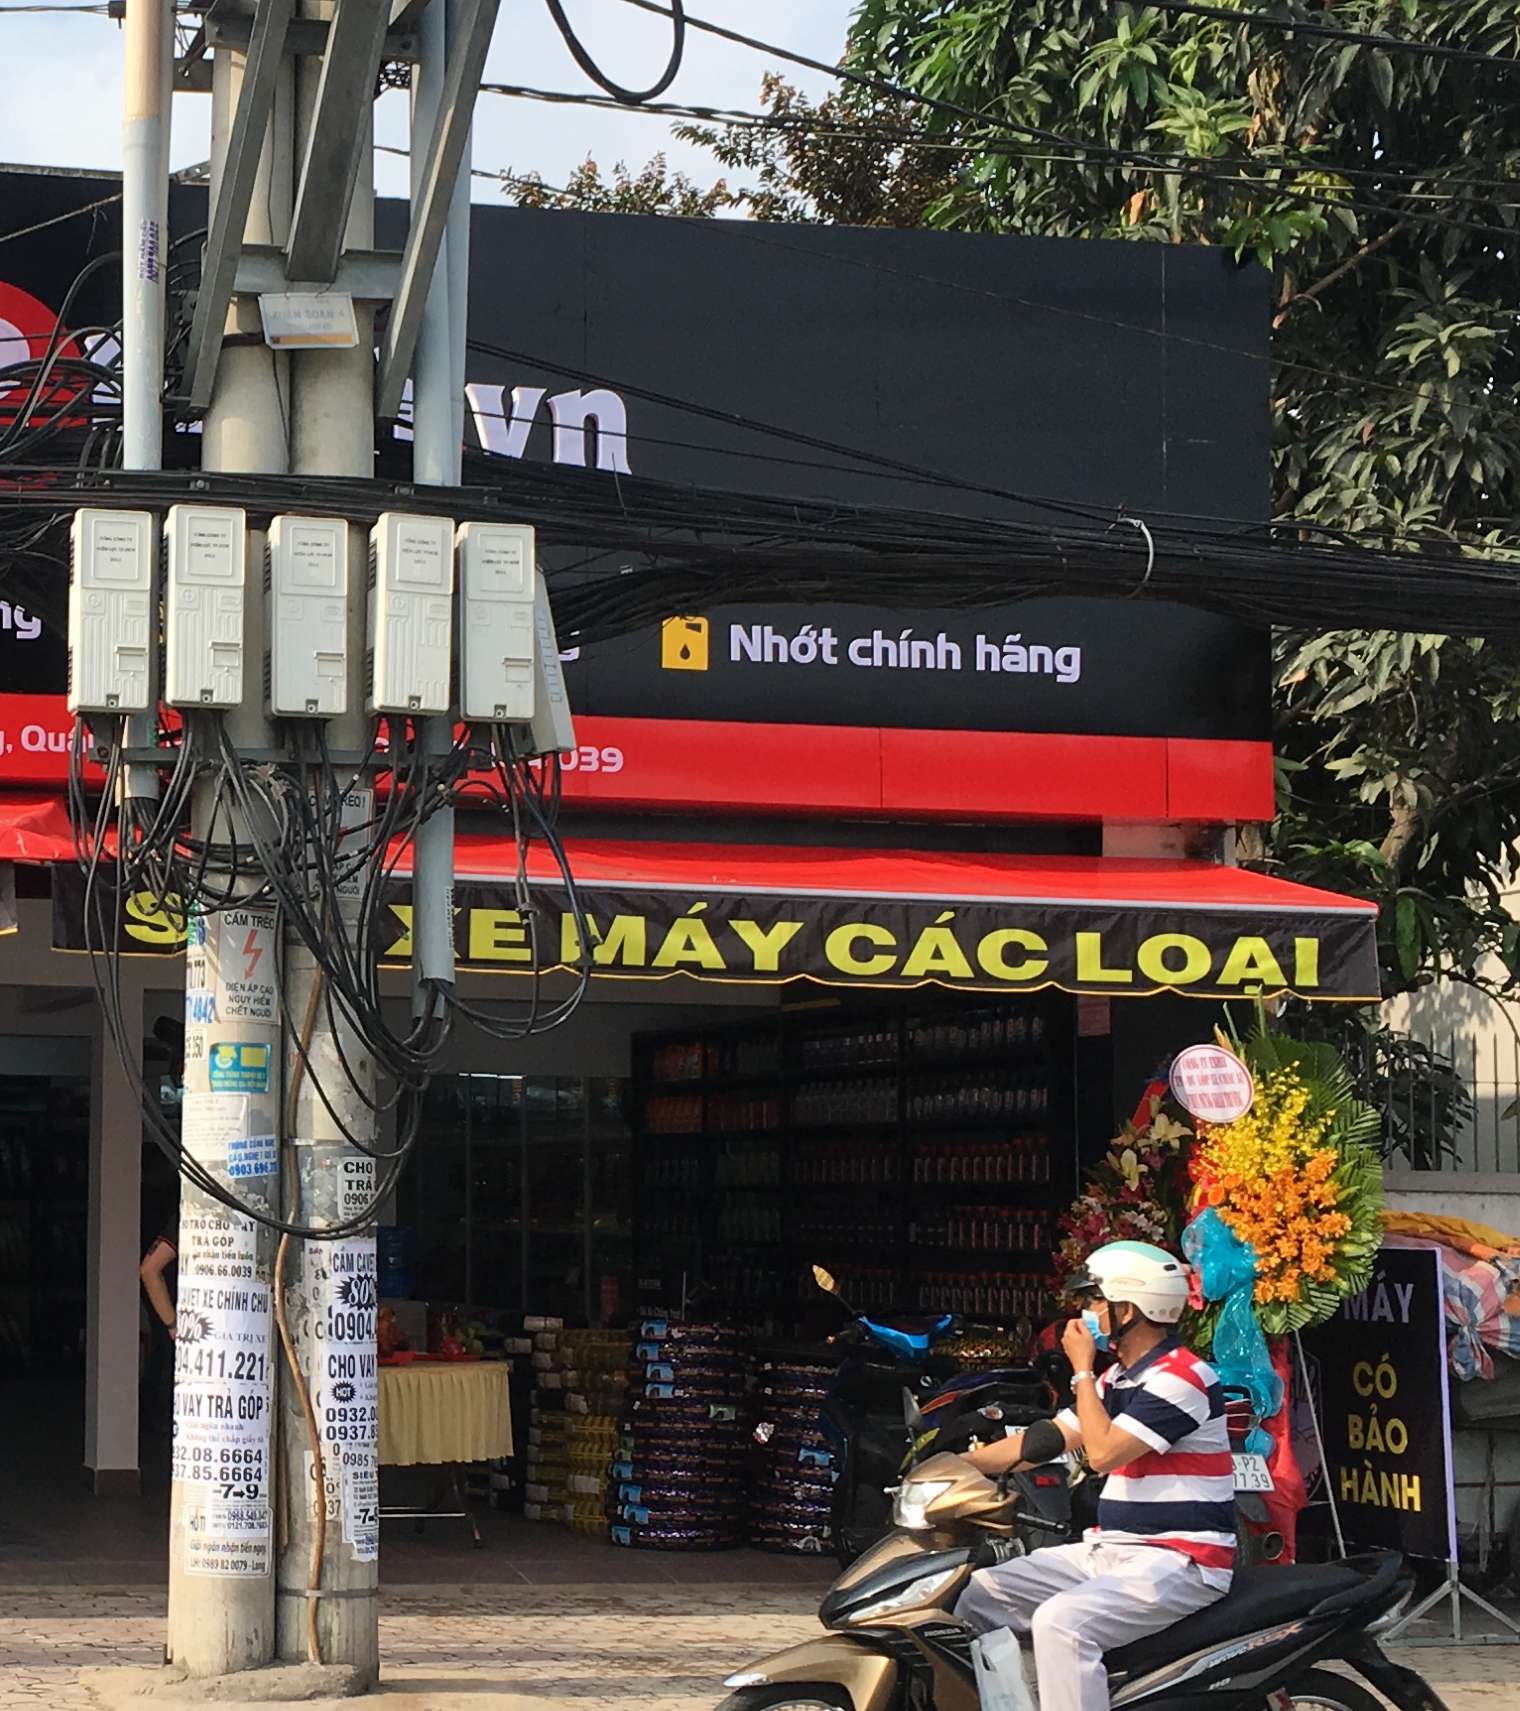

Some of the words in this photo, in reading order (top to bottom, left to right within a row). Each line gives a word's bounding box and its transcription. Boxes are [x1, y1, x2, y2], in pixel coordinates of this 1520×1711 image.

[730, 624, 839, 665] Nhớt
[848, 629, 960, 671] chính
[976, 633, 1081, 683] hãng
[561, 902, 805, 971] MÁY
[825, 910, 1049, 981] CÁC
[1076, 930, 1319, 995] LOẠI
[1343, 1272, 1415, 1324] MÁY
[1352, 1353, 1398, 1400] CÓ
[1347, 1402, 1409, 1455] BẢO
[1340, 1458, 1422, 1512] HÀNH
